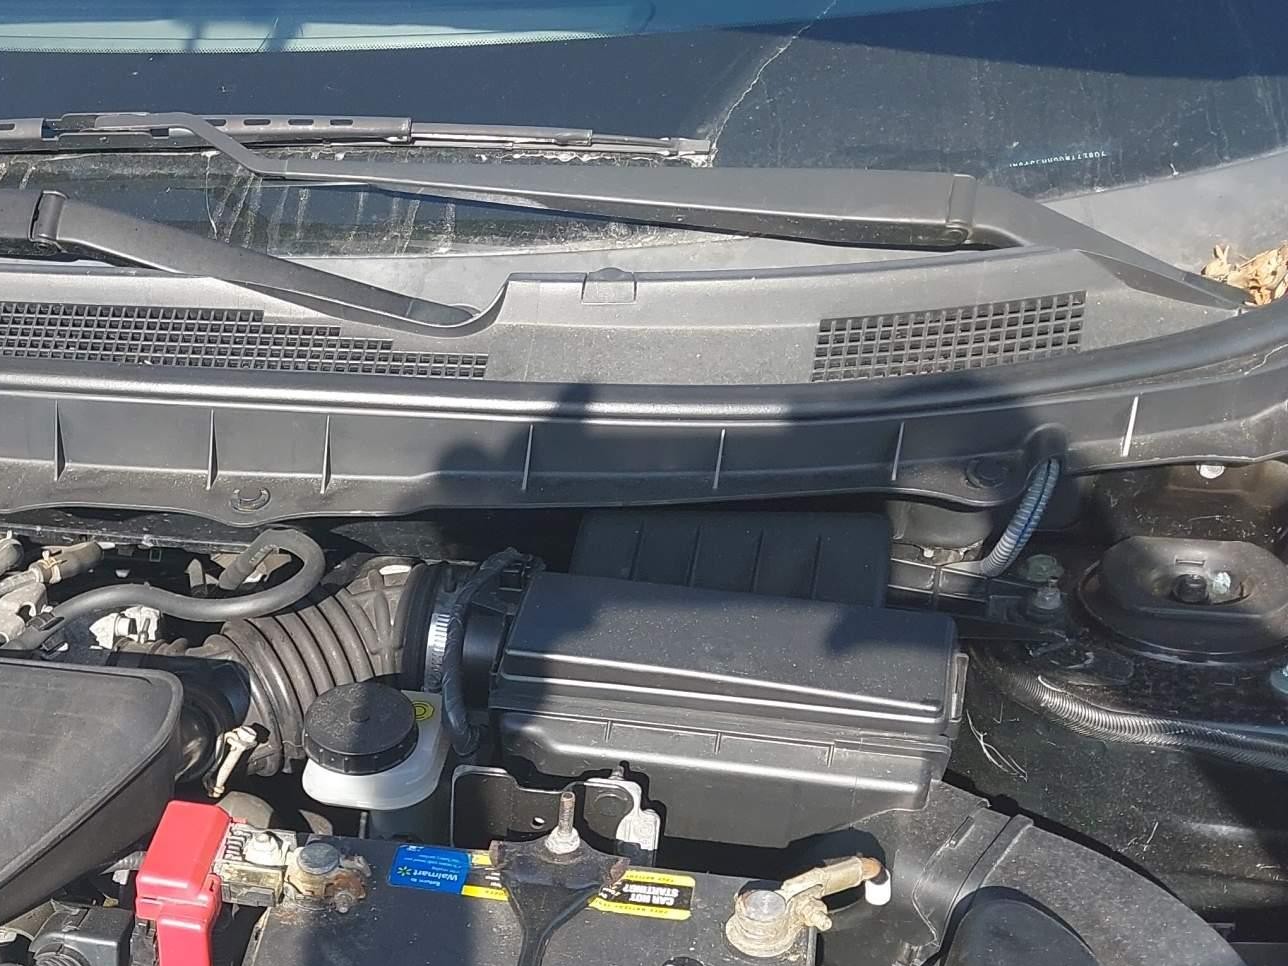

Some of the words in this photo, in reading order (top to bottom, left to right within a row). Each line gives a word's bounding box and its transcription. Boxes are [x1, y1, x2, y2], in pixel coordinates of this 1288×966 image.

[412, 868, 457, 881] Walmart
[622, 880, 679, 900] STARTING?
[628, 892, 650, 903] NOT
[651, 895, 674, 906] CAR
